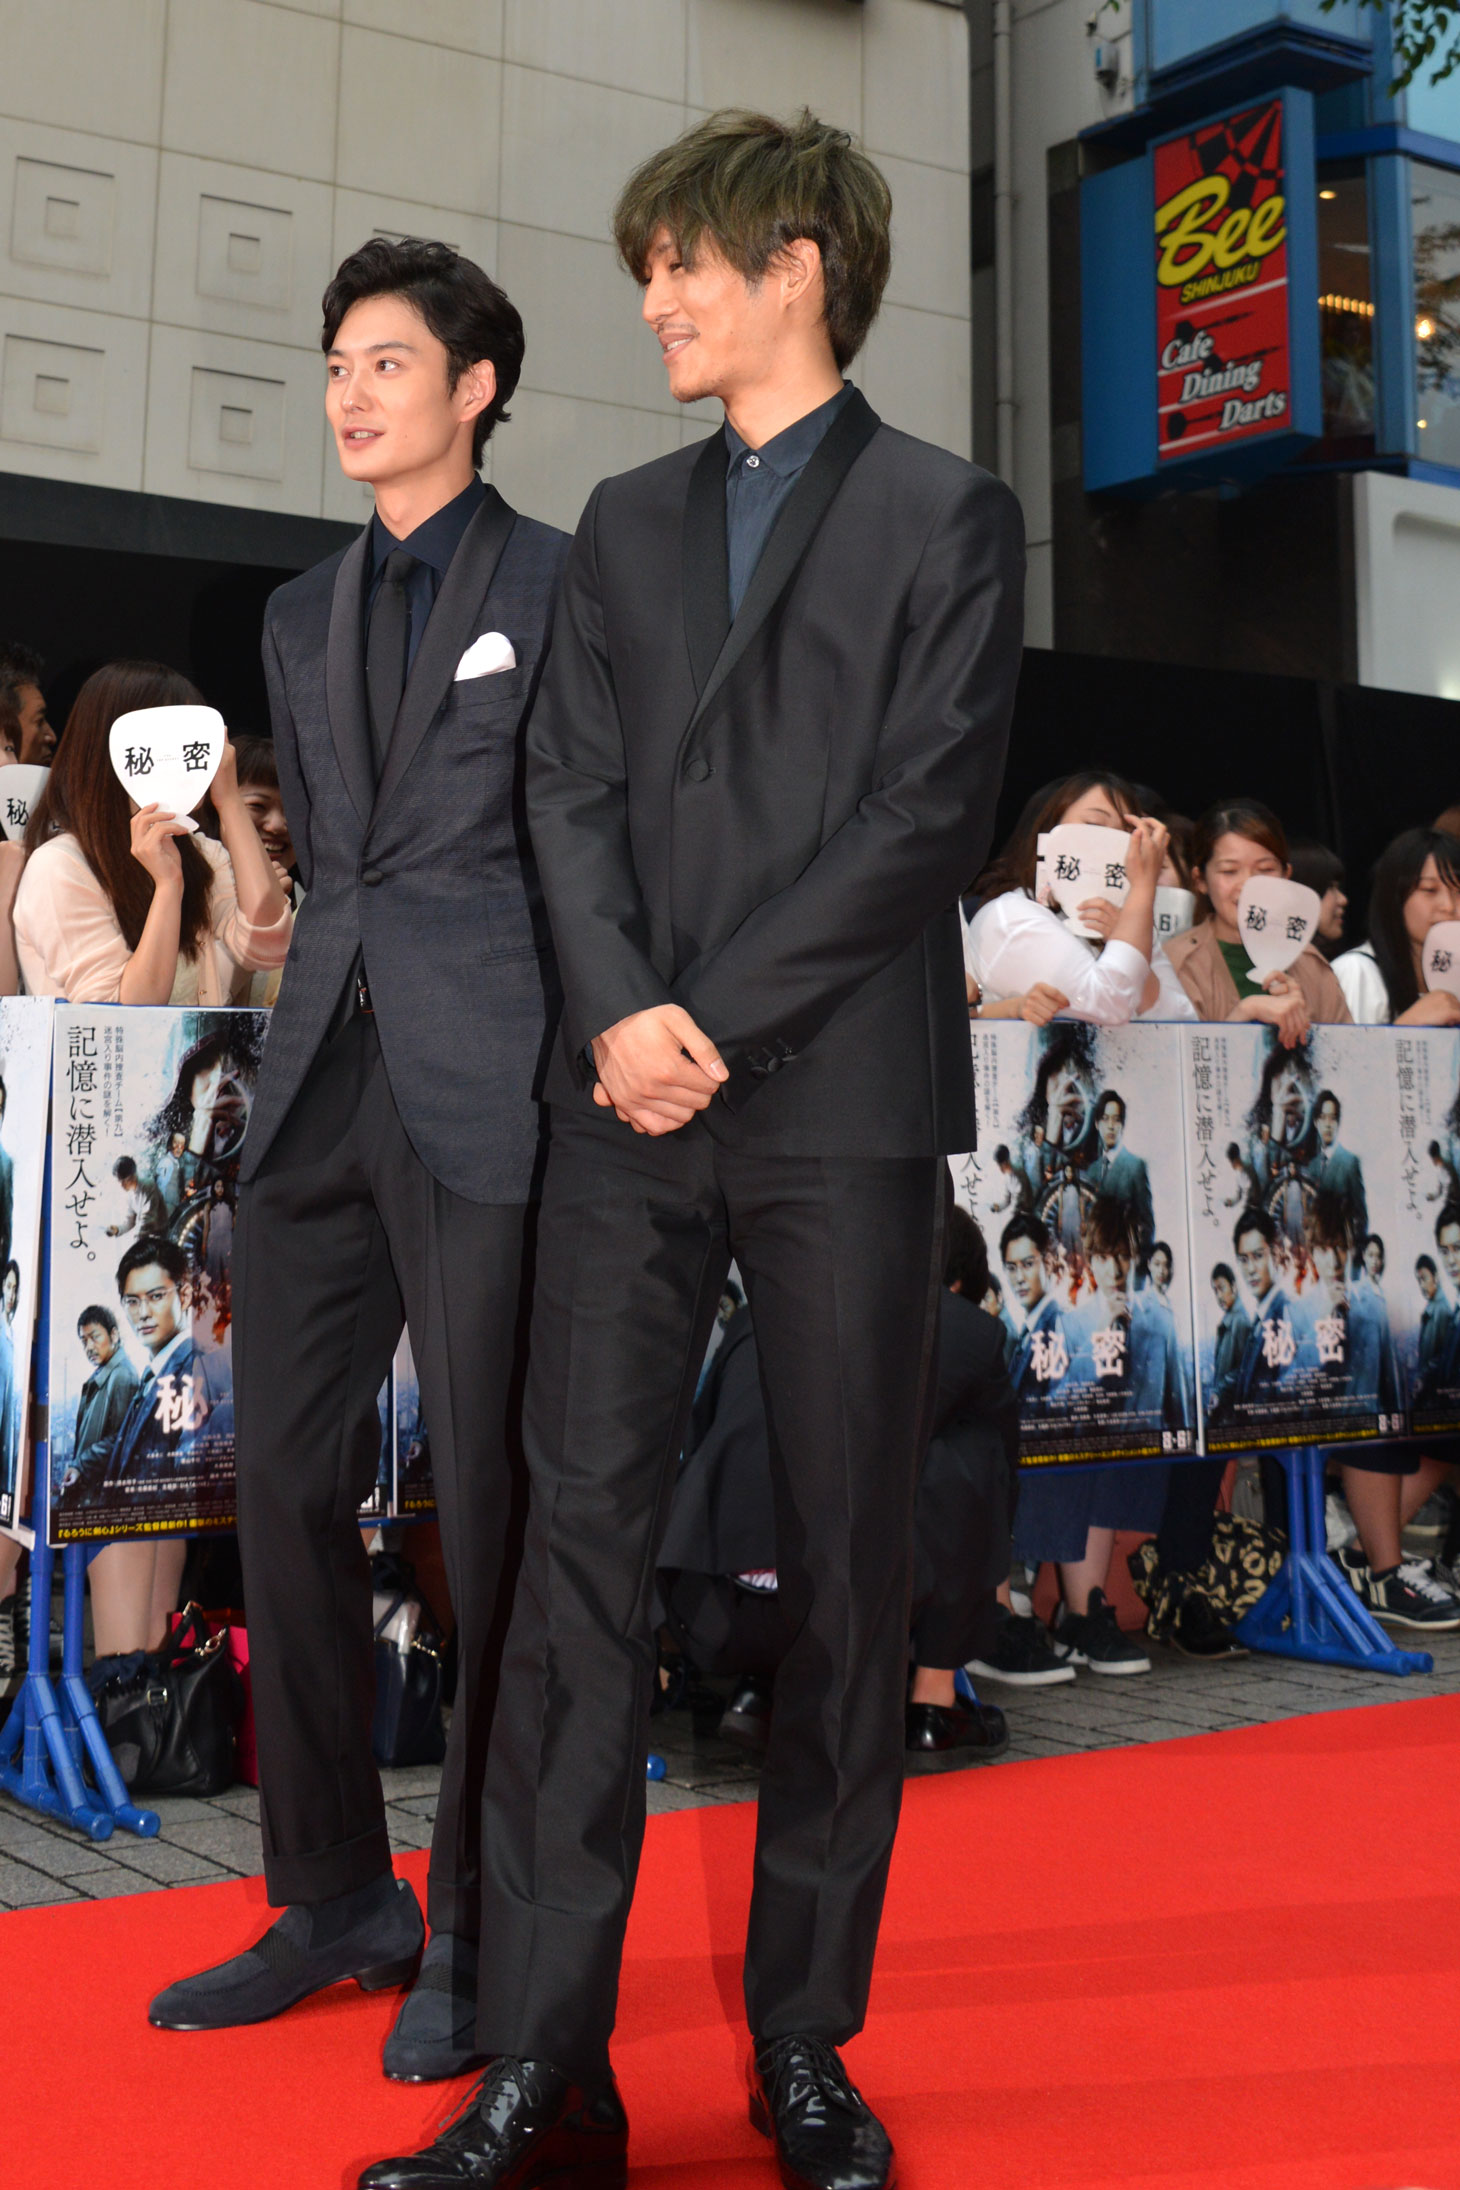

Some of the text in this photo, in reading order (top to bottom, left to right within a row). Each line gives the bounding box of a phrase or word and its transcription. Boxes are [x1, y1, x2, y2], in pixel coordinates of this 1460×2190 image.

[1155, 175, 1287, 286] Bee
[1181, 261, 1260, 304] SHINJUKU
[1180, 359, 1263, 402] Dining
[1219, 390, 1287, 431] Darts
[65, 1025, 98, 1262] 記憶に潜入せよ。
[154, 1374, 209, 1434] 秘
